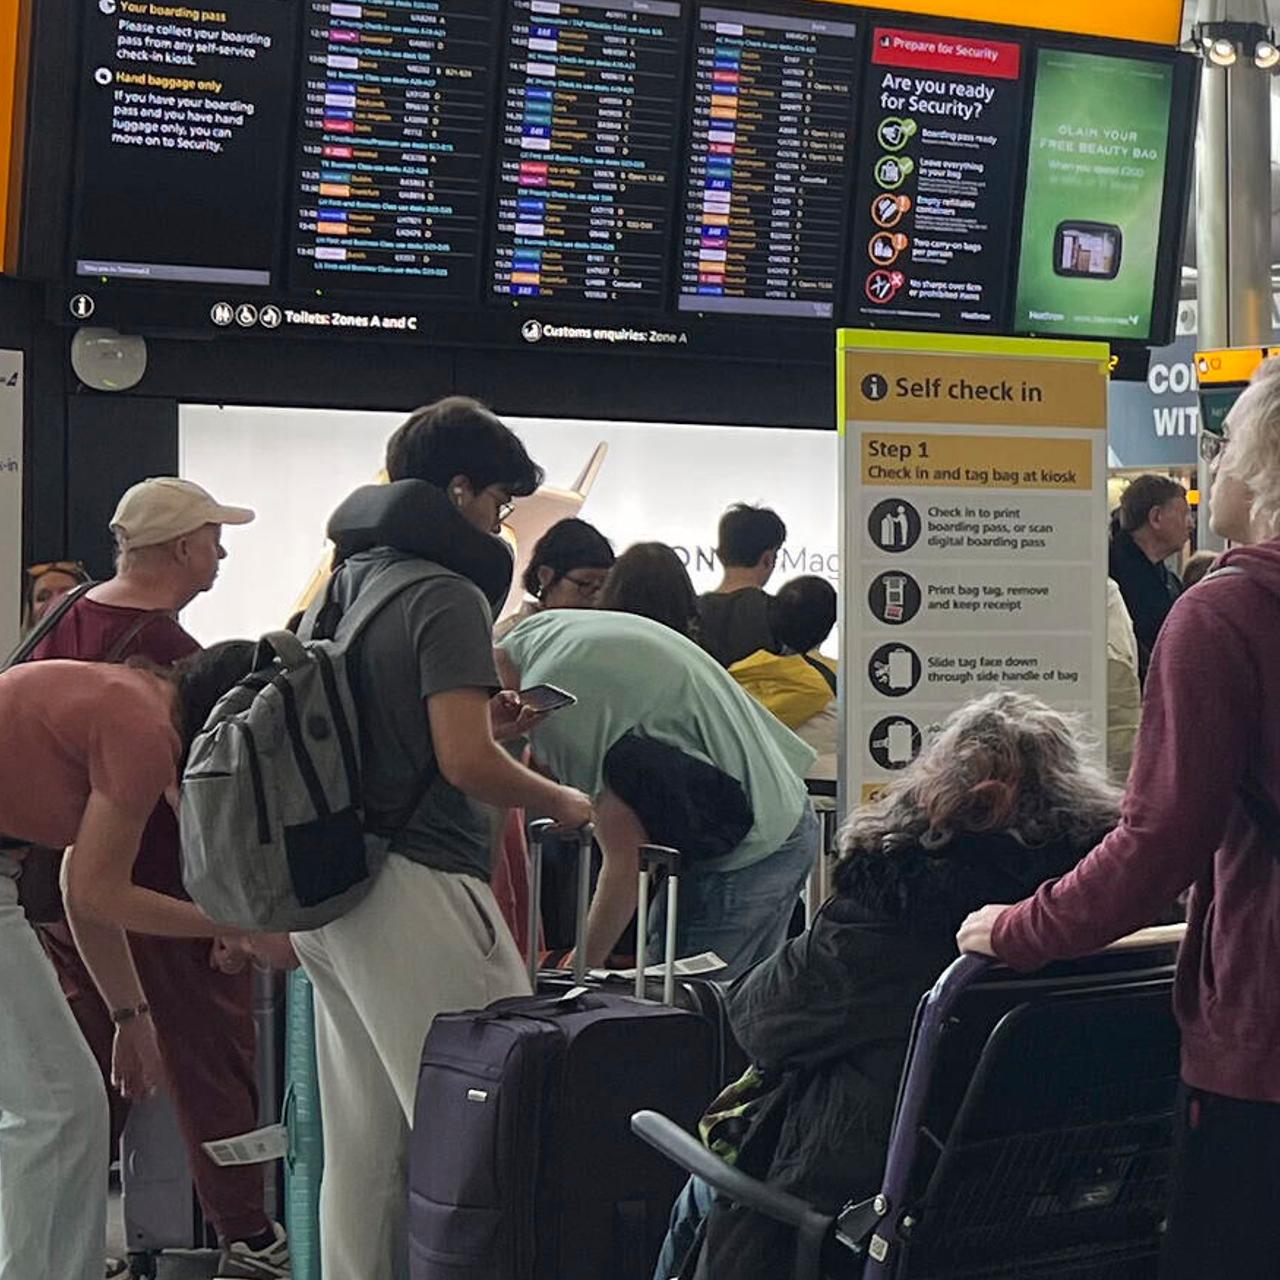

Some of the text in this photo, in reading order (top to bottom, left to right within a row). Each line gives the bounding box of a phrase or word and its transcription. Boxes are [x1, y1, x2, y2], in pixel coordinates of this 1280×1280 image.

[120, 0, 226, 23] Your boarding pass
[118, 20, 271, 47] Please collect your boarding
[117, 35, 256, 58] pass from any self-service
[893, 37, 999, 62] Prepare for Security
[116, 49, 196, 66] check-in kiosk.
[116, 72, 222, 93] Hand baggage only
[881, 73, 995, 103] Are you ready
[114, 90, 254, 115] If you have your boarding
[880, 92, 982, 121] for Security?
[113, 106, 244, 126] pass and you have hand
[112, 119, 158, 134] luggage
[190, 127, 211, 138] you
[213, 128, 232, 138] can
[111, 133, 143, 145] move
[145, 137, 160, 147] on
[163, 137, 175, 148] to
[1039, 138, 1158, 160] FREE BEAUTY BAG
[285, 309, 417, 330] Toilets: Zones A and C
[542, 325, 688, 344] Customs enquiries: Zone A
[896, 377, 1042, 402] Self check in
[1153, 406, 1199, 437] WIT
[868, 440, 929, 461] Step 1
[868, 465, 1076, 485] Check in and tag bag at kiosk
[928, 507, 1020, 520] Check in to print
[928, 522, 1054, 535] boarding pass, or scan
[928, 536, 1046, 549] digital boarding pass
[928, 585, 1049, 598] Print bag tag, remove
[928, 599, 1022, 612] and keep receipt
[928, 656, 1038, 669] Slide tag face down
[928, 670, 1079, 682] through side handle of bag
